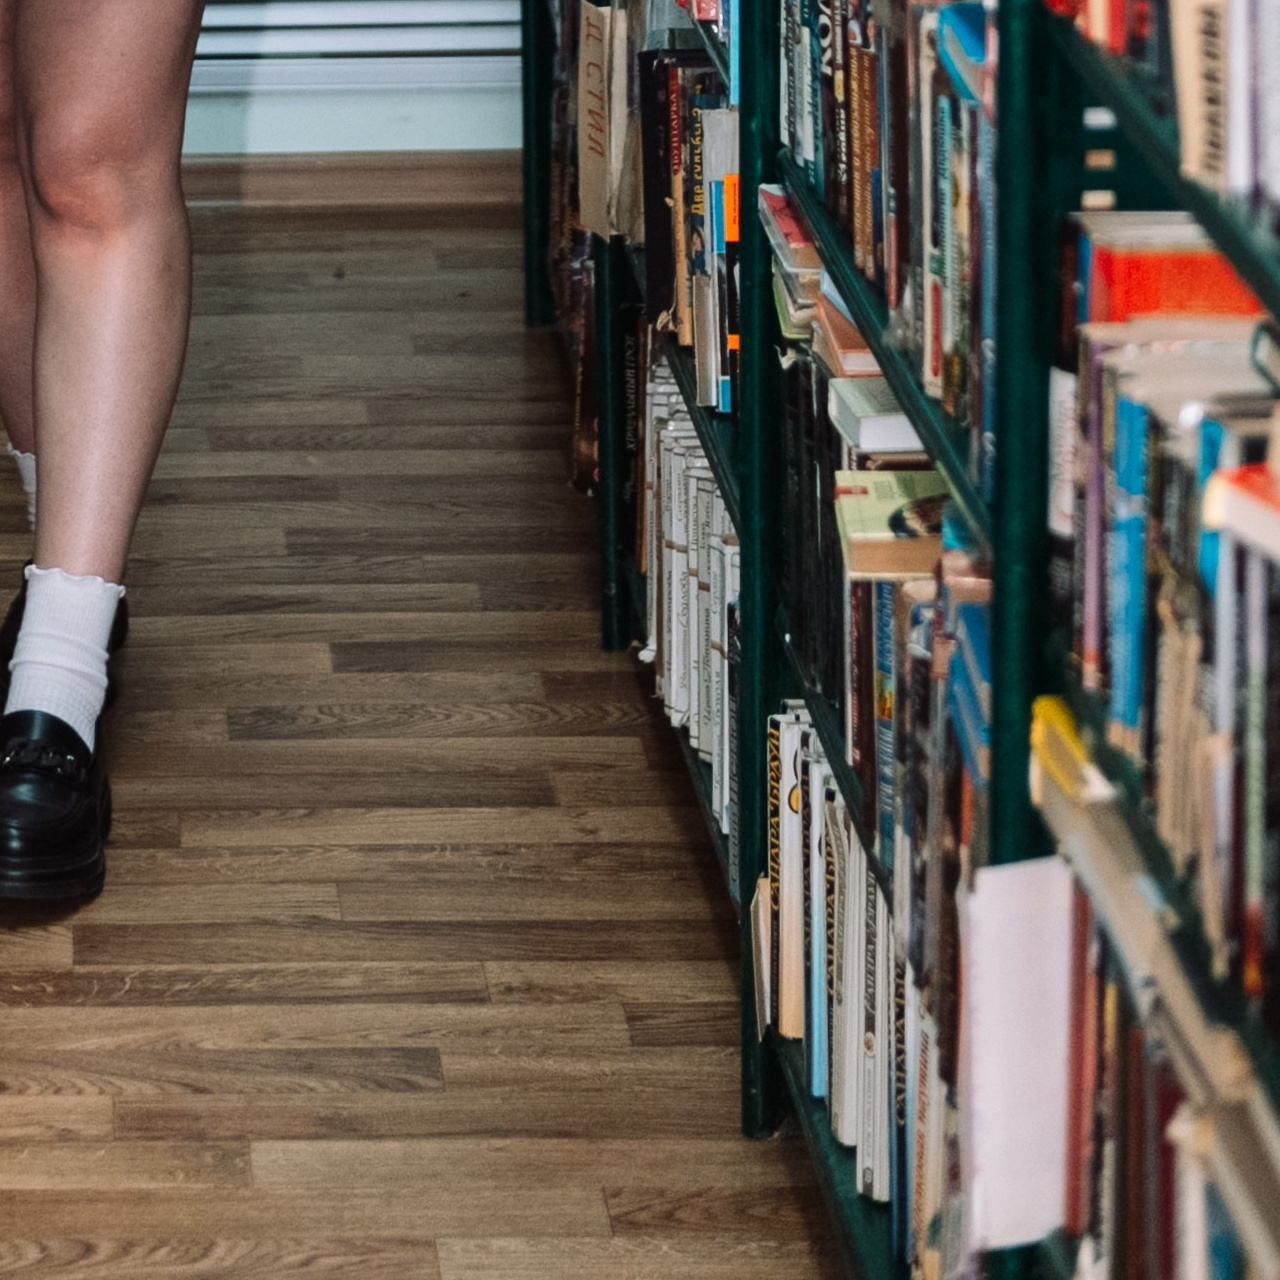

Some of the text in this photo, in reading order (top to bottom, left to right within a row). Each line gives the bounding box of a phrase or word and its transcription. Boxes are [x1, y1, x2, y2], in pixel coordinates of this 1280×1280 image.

[587, 60, 606, 158] СТИЛ
[768, 727, 780, 912] САНДРА БРАУН
